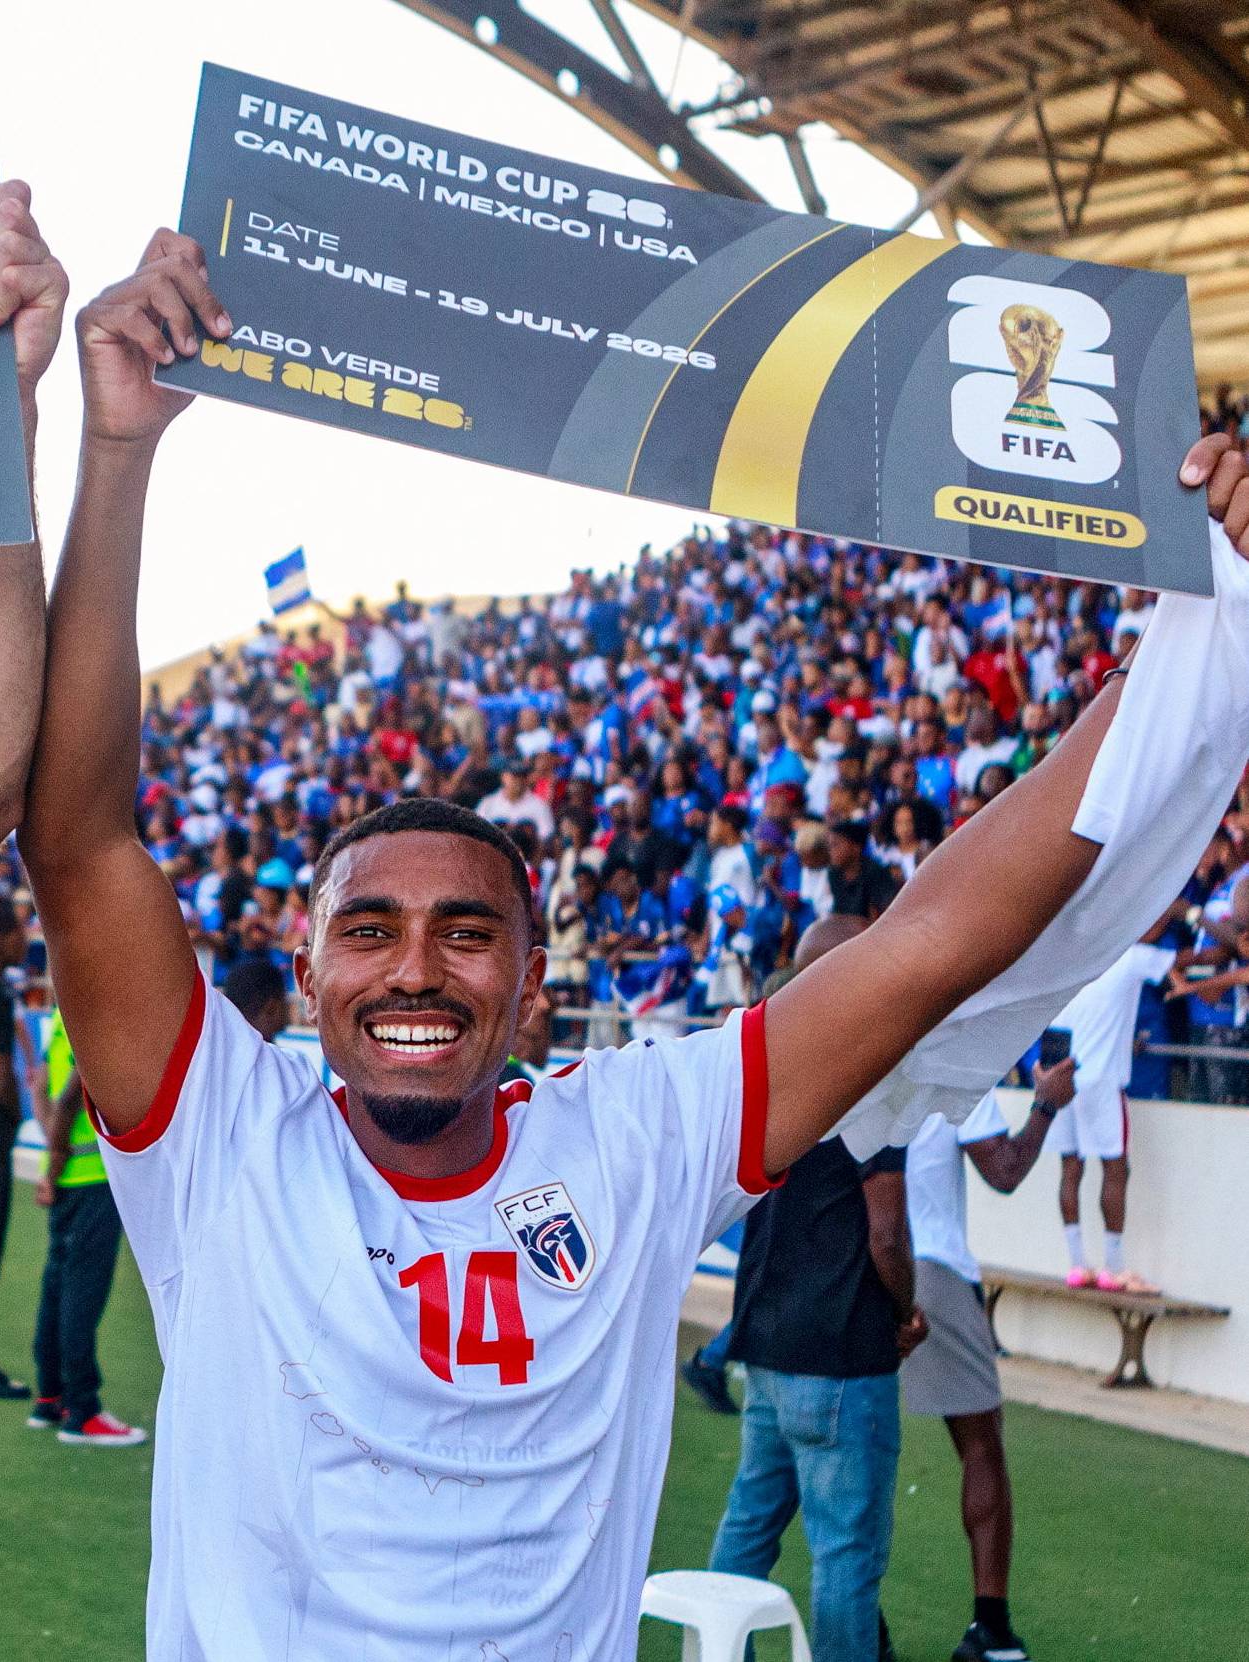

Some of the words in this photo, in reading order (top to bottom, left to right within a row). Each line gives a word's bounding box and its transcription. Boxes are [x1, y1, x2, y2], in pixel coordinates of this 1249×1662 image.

[238, 94, 329, 142] FIFA
[336, 121, 489, 183] WORLD
[495, 166, 580, 206] CUP
[234, 130, 411, 194] CANADA
[434, 185, 592, 240] MEXICO
[614, 230, 699, 266] USA
[248, 211, 341, 253] DATE
[243, 234, 291, 264] 11
[297, 254, 408, 297] JUNE
[437, 288, 490, 317] 19
[495, 308, 600, 343] JULY
[606, 332, 718, 371] 2026
[200, 338, 276, 383] WE
[382, 388, 466, 430] 26
[228, 325, 312, 359] ABO
[319, 345, 441, 394] VERDE
[1001, 432, 1077, 463] FIFA
[953, 495, 1128, 540] QUALIFIED
[503, 1190, 559, 1221] FCF
[397, 1251, 535, 1387] 14
